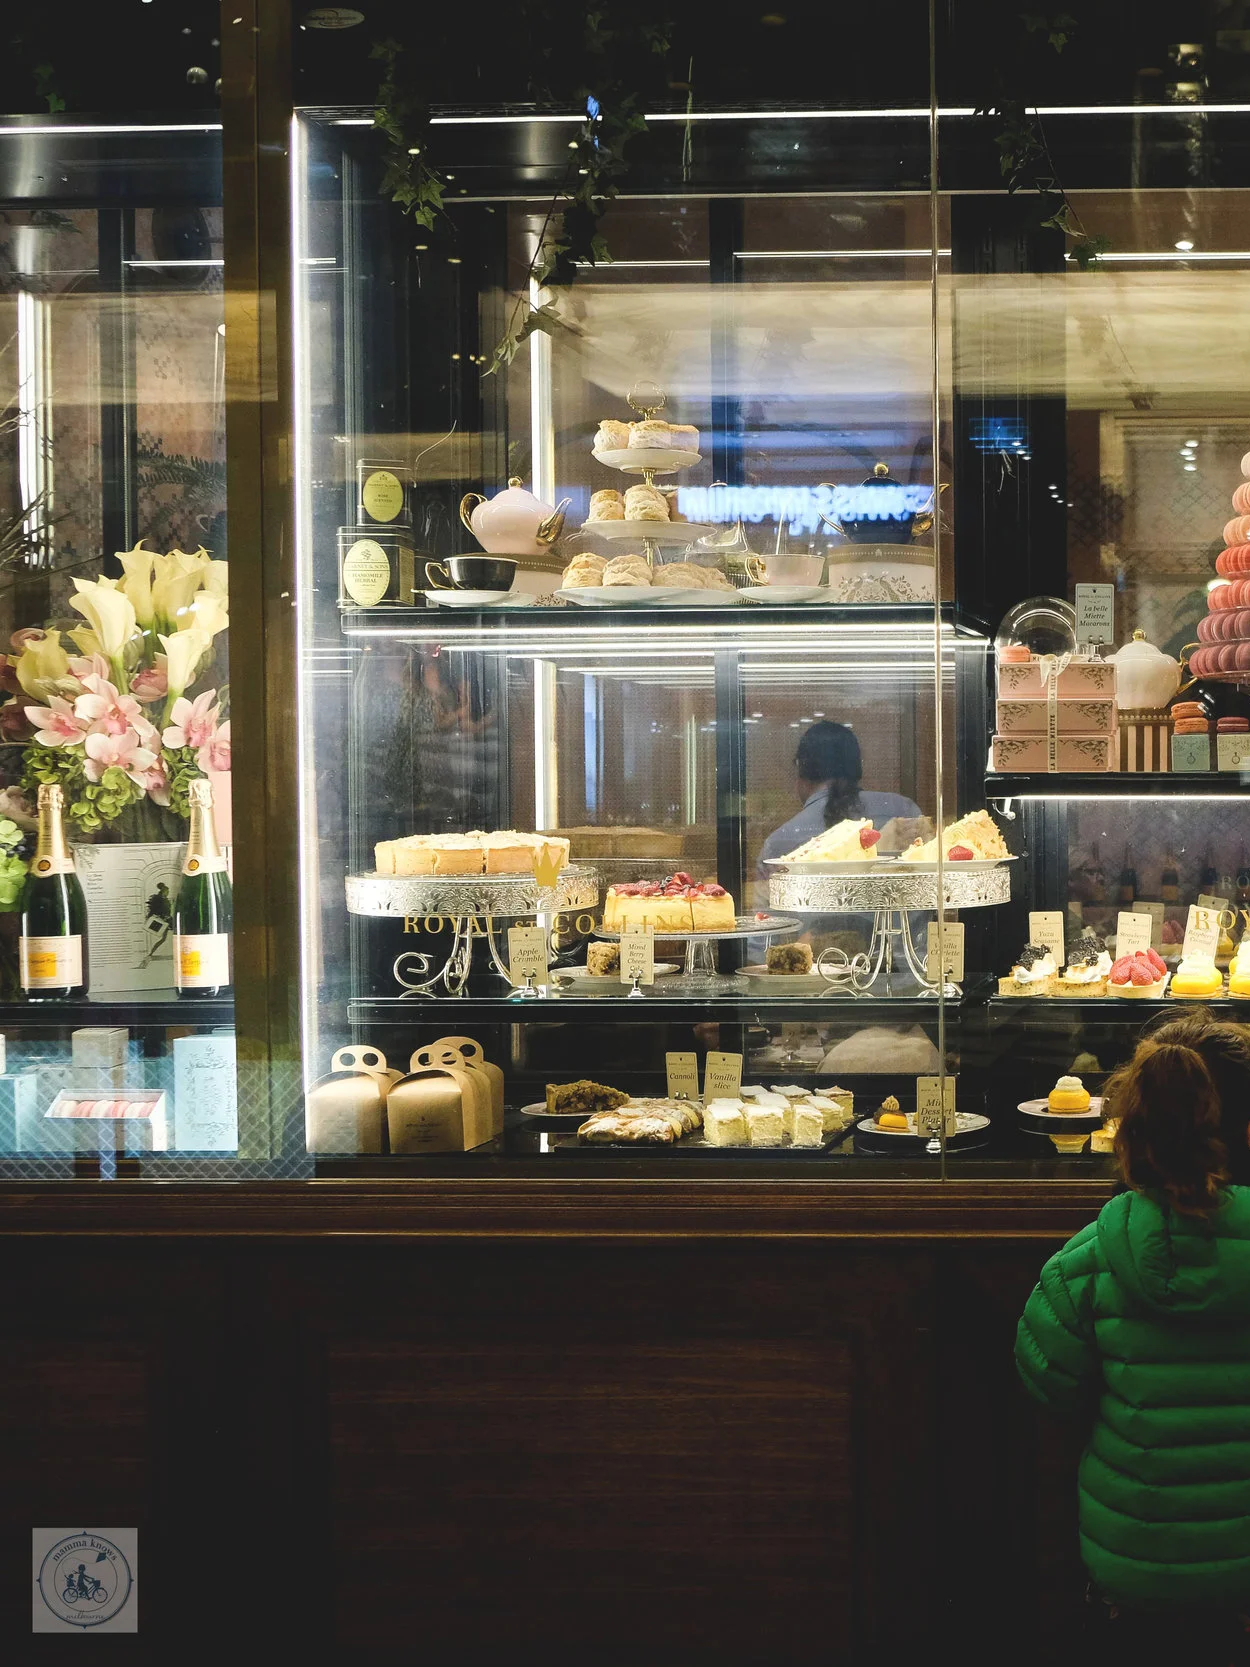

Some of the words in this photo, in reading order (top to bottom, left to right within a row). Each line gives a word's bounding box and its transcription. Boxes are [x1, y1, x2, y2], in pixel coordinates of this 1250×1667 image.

[1050, 762, 1056, 771] LA
[402, 914, 502, 934] ROYAL
[553, 913, 693, 935] COLLINS
[627, 943, 646, 951] Mixed
[517, 948, 539, 956] Apple
[629, 950, 645, 959] Berry
[669, 1072, 695, 1080] Cannoli
[709, 1072, 737, 1082] Vanilla
[713, 1082, 731, 1090] slice
[920, 1108, 952, 1116] Dessrt
